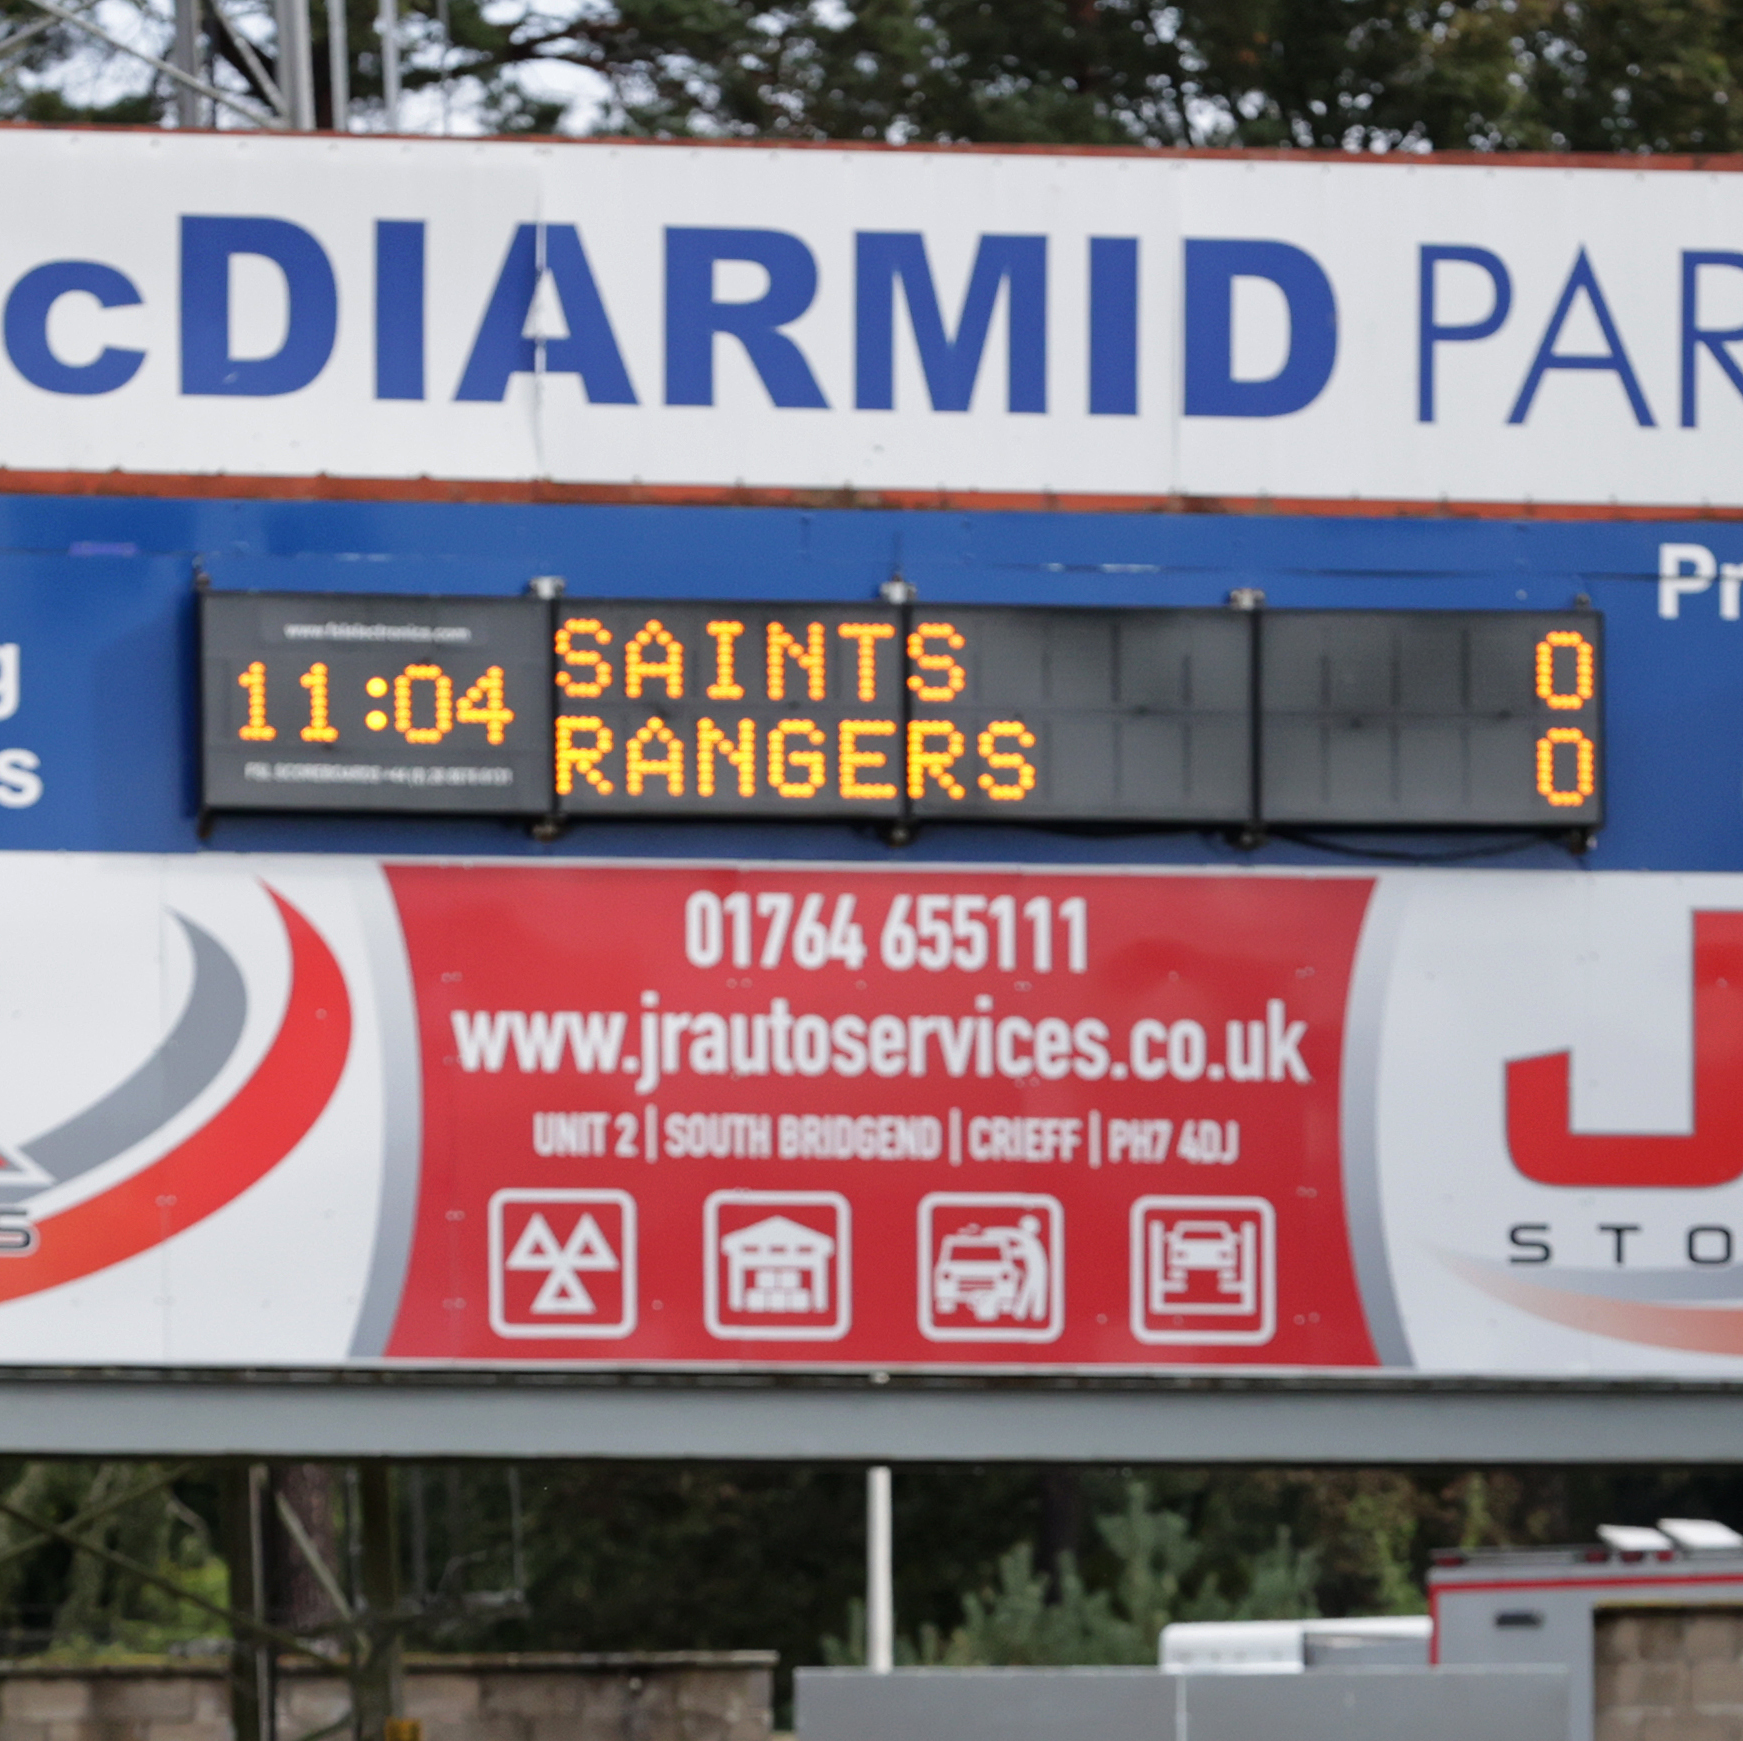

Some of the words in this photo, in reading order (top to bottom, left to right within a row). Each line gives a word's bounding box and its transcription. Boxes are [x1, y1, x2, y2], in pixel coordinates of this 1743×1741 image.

[238, 661, 515, 745] 11:04
[555, 618, 966, 703] SAINTS
[1535, 630, 1594, 710] 0
[555, 714, 1036, 802] RANGERS
[1535, 727, 1595, 807] 0
[685, 890, 867, 970] 01764
[878, 893, 1088, 973] 655111
[451, 990, 1311, 1095] www.jrautoservices.co.uk
[532, 1111, 612, 1159] UNIT
[613, 1111, 639, 1159] 2
[664, 1112, 773, 1159] SOUTH
[777, 1114, 943, 1161] BRIDGEND
[968, 1115, 1084, 1163] CRIEFF
[1107, 1117, 1174, 1164] PH7
[1175, 1118, 1241, 1166] 4DJ
